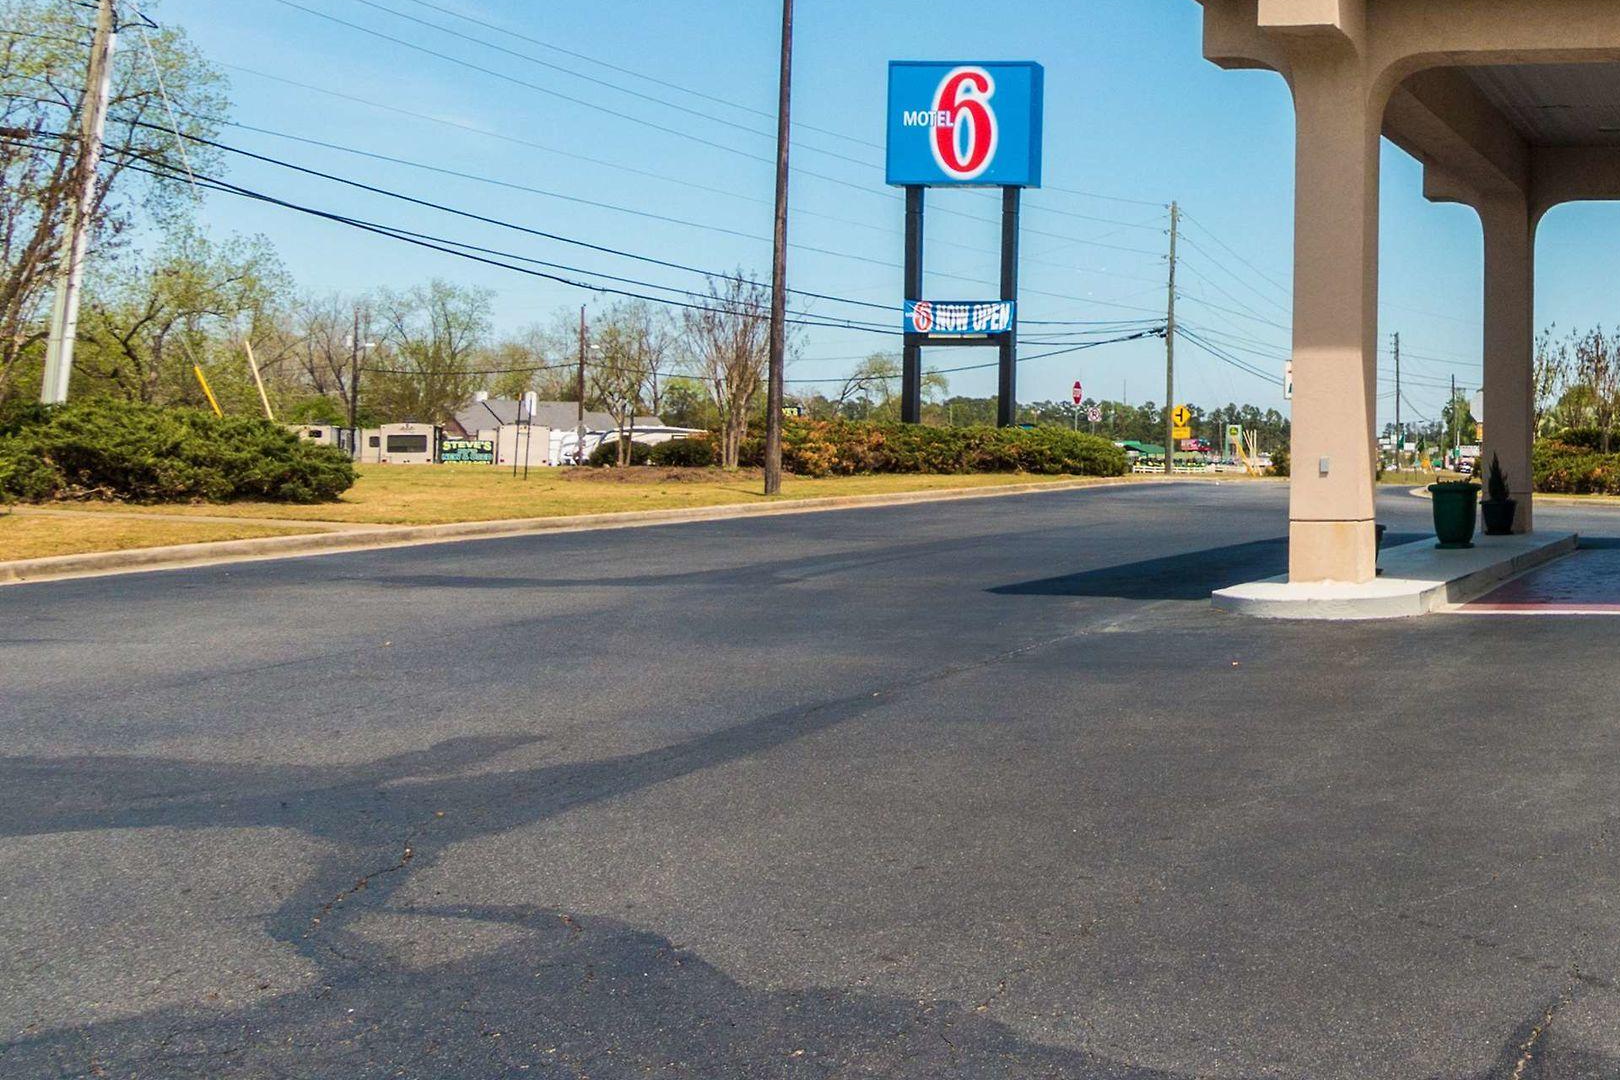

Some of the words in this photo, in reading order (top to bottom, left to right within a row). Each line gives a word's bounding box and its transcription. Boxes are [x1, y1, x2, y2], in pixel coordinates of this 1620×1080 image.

[903, 110, 954, 127] MOTEL
[930, 66, 998, 180] 6
[972, 303, 1010, 331] OPEN
[442, 440, 492, 450] STEVE'S
